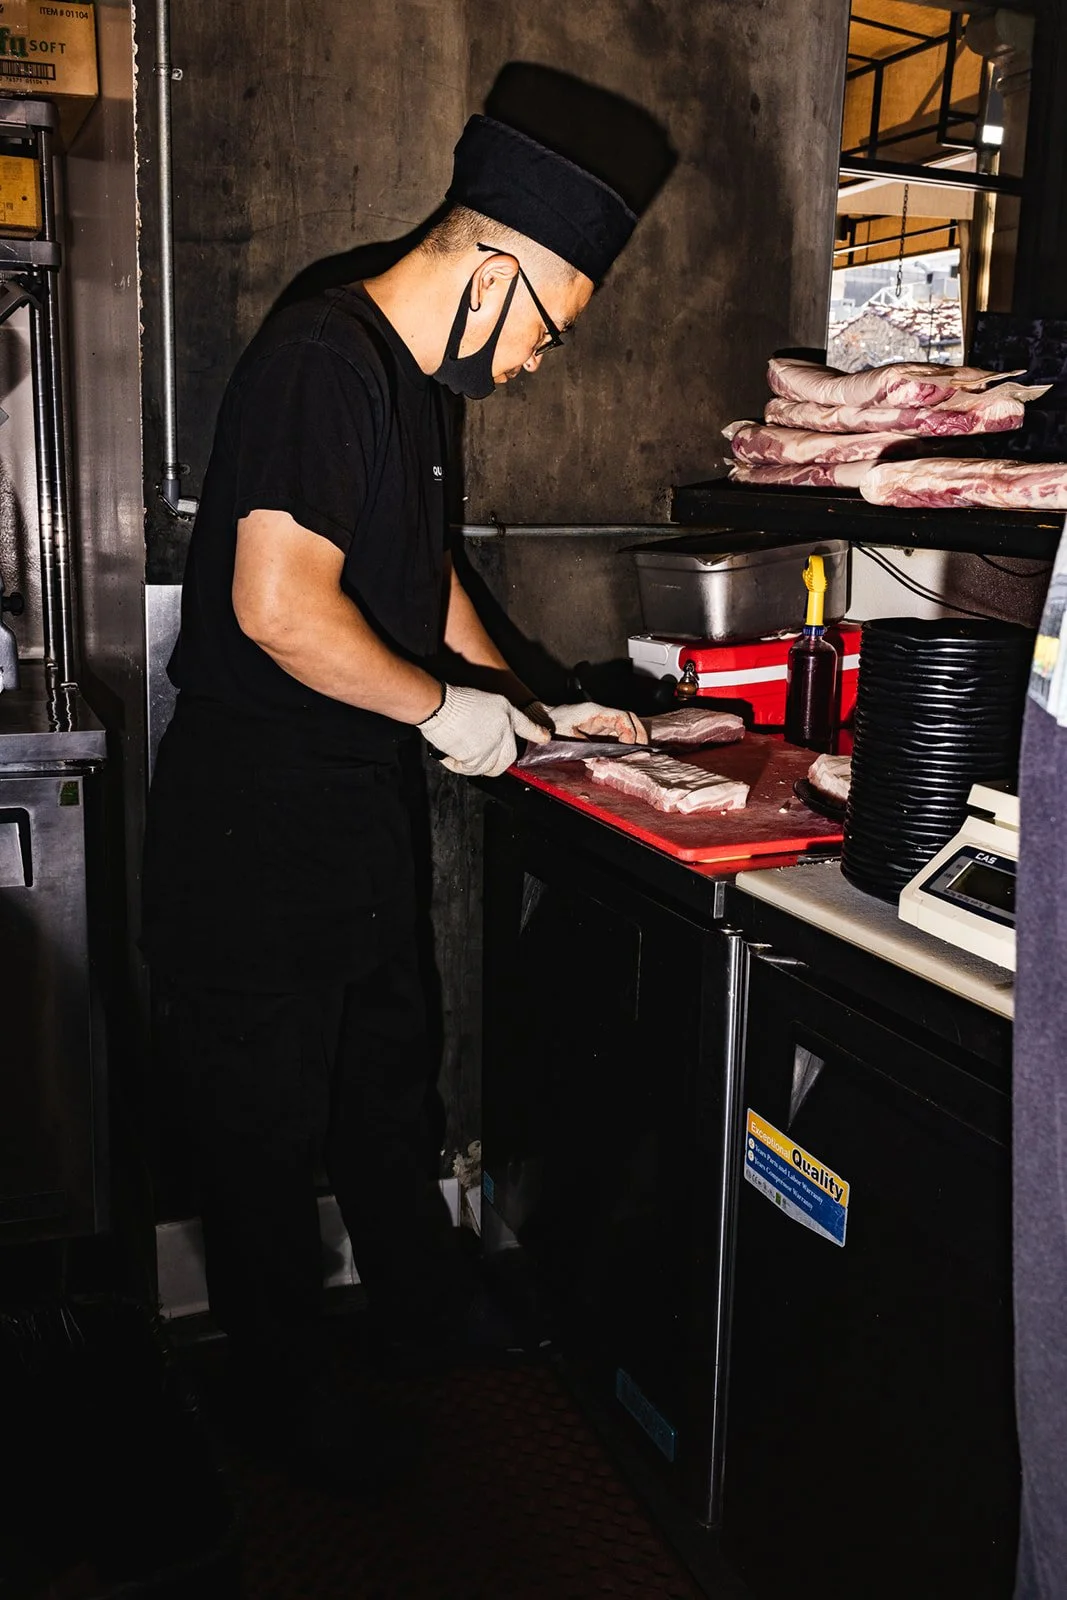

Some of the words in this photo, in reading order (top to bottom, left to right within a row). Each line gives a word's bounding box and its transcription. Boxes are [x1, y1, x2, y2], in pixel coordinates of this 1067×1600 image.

[40, 6, 59, 16] ITEM
[59, 9, 65, 17] #
[65, 10, 89, 20] 01104
[29, 40, 66, 54] SOFT
[975, 853, 997, 864] CAS
[751, 1121, 791, 1160] Exceptional
[792, 1148, 843, 1202] Quality
[755, 1144, 767, 1158] Years
[778, 1165, 788, 1176] and
[788, 1171, 801, 1185] Labor
[801, 1181, 823, 1206] Warranty
[792, 1187, 813, 1211] Warranty
